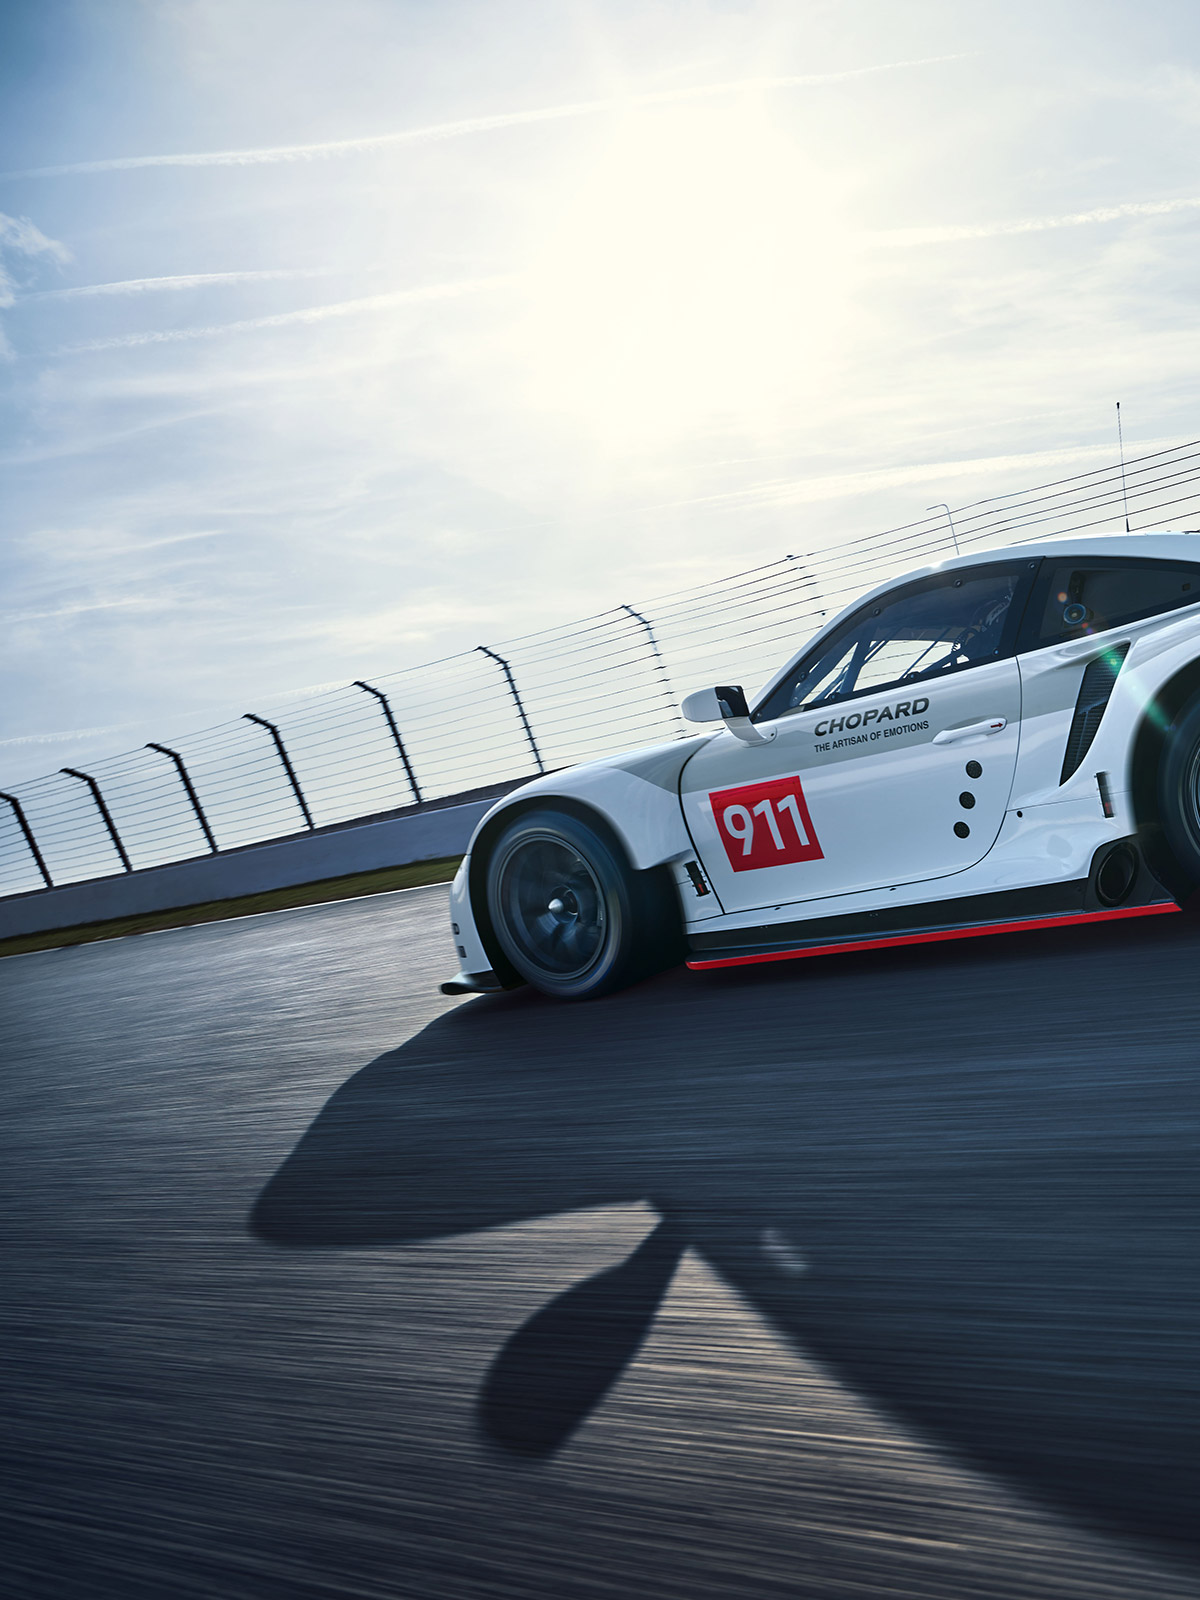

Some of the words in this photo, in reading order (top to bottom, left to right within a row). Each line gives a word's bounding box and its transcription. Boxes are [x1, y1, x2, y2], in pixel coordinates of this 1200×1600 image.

[814, 698, 930, 737] CHOPARD
[814, 742, 831, 753] THE
[832, 734, 868, 750] ARTISAN
[869, 730, 882, 741] OF
[883, 720, 930, 738] EMOTIONS
[722, 794, 811, 857] 911
